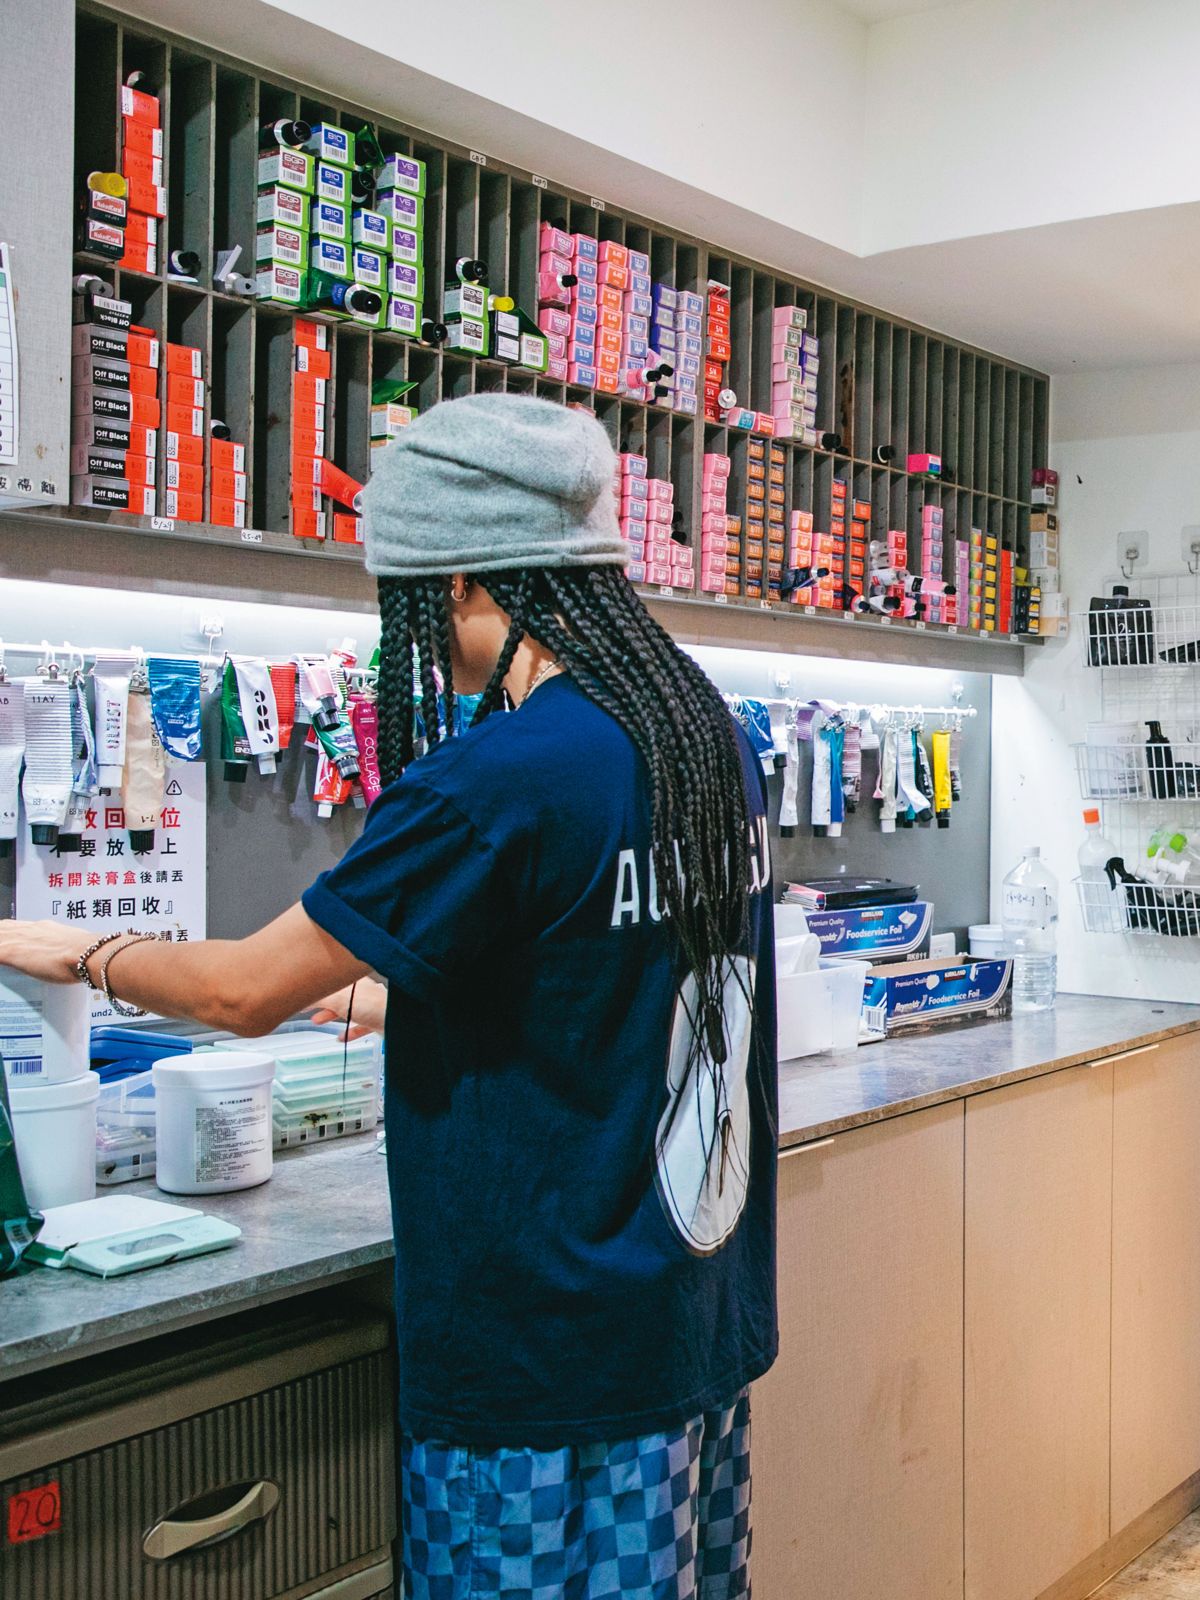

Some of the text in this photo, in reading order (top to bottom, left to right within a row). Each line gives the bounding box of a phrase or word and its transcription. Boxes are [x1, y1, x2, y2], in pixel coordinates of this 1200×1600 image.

[92, 339, 106, 347] Off
[106, 341, 126, 352] Black
[94, 370, 128, 382] Off Black
[94, 400, 128, 412] Off Black
[96, 430, 128, 441] Off Black
[90, 459, 124, 470] Off Black
[94, 489, 127, 501] Off Black
[364, 736, 381, 792] COLLAGE
[84, 807, 181, 829] 回位
[48, 869, 184, 888] 拆開染膏盒後請丟
[809, 918, 845, 927] Premium Quality
[846, 925, 903, 940] Foodservice Foil
[895, 979, 914, 988] Premium
[928, 988, 980, 1006] Foodservice Foil
[17, 1491, 58, 1537] 20
